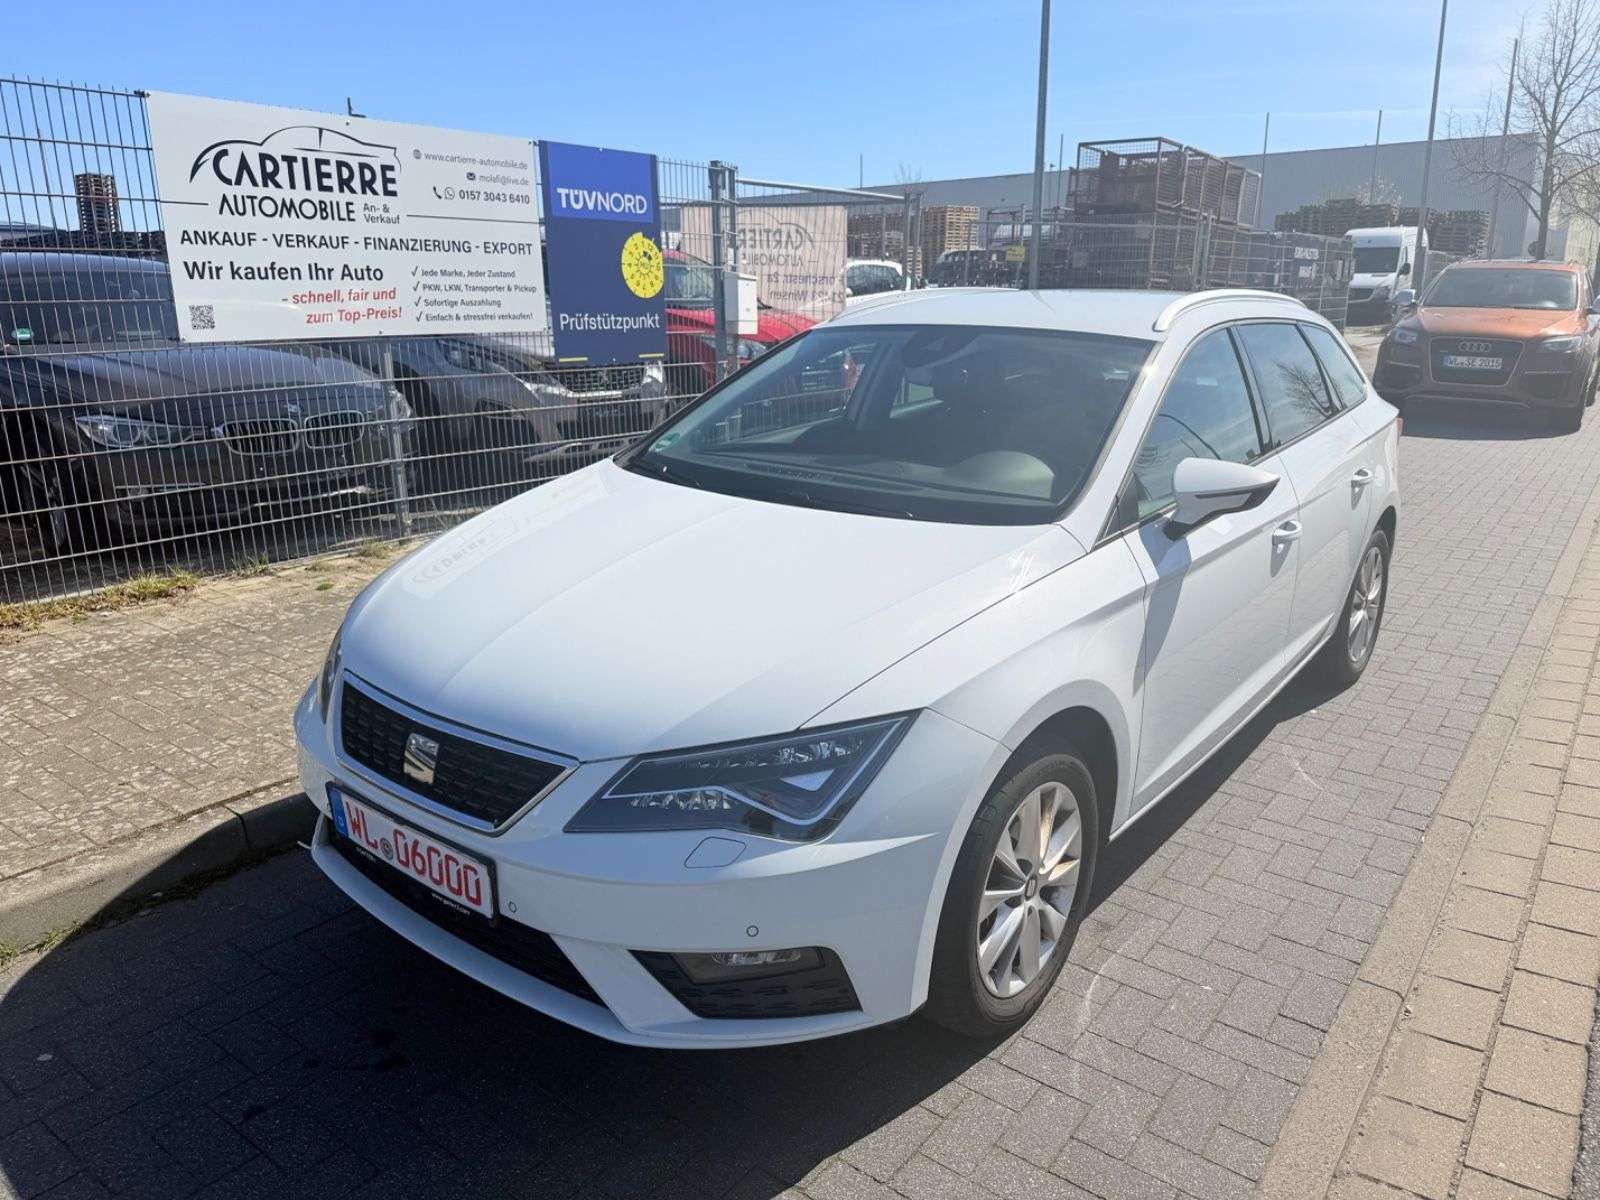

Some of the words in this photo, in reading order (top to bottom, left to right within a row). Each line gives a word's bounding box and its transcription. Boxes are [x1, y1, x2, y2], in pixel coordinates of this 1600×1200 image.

[424, 152, 528, 170] www.cartierre-automobile.de
[212, 148, 398, 197] CARTIERRE
[459, 189, 480, 201] 0157
[483, 191, 507, 203] 3043
[509, 194, 530, 204] 6410
[219, 193, 356, 223] AUTOMOBILE
[363, 202, 381, 213] An-
[382, 203, 390, 213] &
[363, 213, 401, 225] Verkauf
[180, 230, 257, 247] ANKAUF
[274, 234, 350, 250] VERKAUF
[363, 237, 472, 253] FINANZIERUNG
[483, 242, 533, 256] EXPORT
[183, 260, 223, 280] Wir
[230, 260, 301, 281] kaufen
[308, 262, 336, 281] Ihr
[340, 263, 384, 281] Auto
[421, 269, 438, 278] Jede
[440, 269, 466, 279] Marke,
[467, 270, 485, 278] Jeder
[487, 269, 516, 279] Zustand
[292, 288, 344, 305] schnell,
[348, 288, 369, 301] fair
[373, 287, 396, 300] und
[422, 283, 442, 293] PKW,
[444, 284, 463, 293] LKW,
[464, 284, 505, 293] Transporter
[507, 284, 512, 292] &
[514, 284, 537, 293] Pickup
[424, 299, 459, 308] Sofortige
[460, 299, 502, 308] Auszahlung
[306, 312, 334, 324] zum
[338, 306, 402, 324] Top-Preis!
[425, 313, 454, 321] Einfach
[463, 313, 497, 321] stressfrei
[499, 312, 533, 321] verkaufen!
[559, 312, 661, 335] Prüfstützpunkt
[345, 801, 379, 850] WL
[393, 828, 482, 906] 06000
